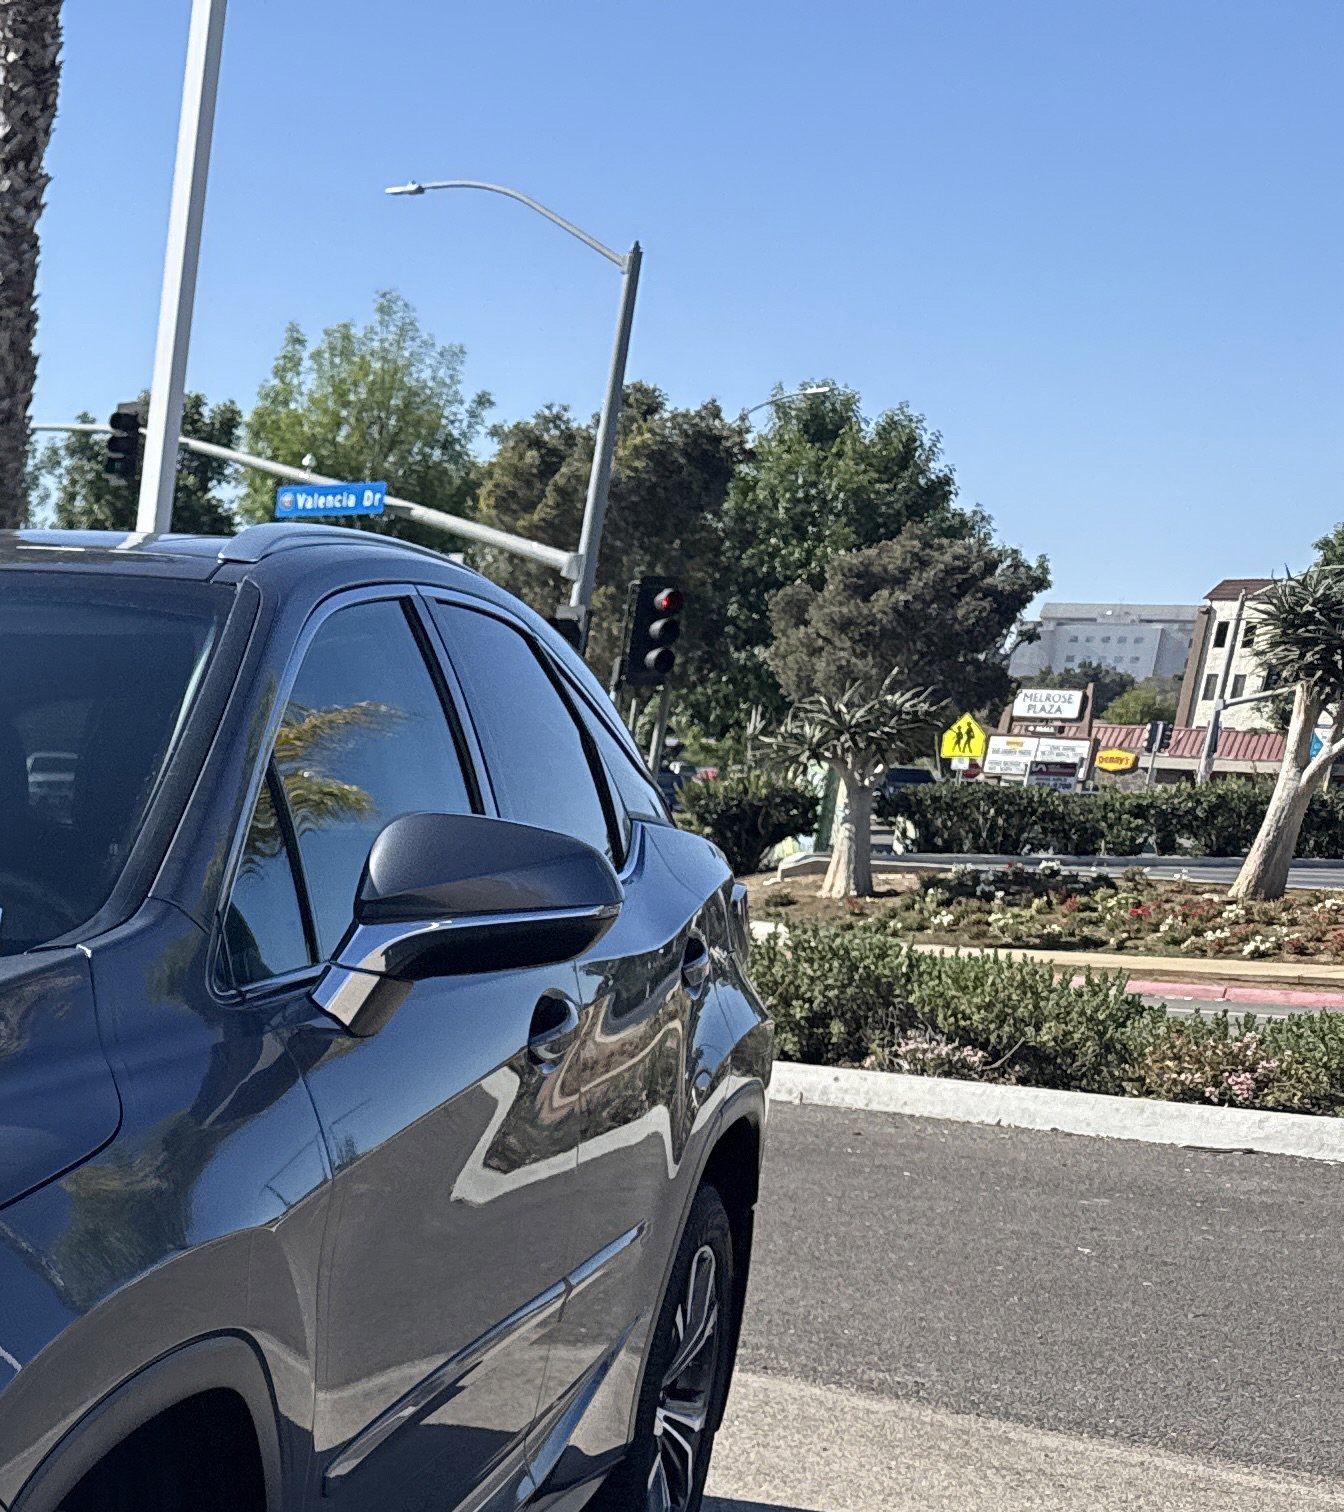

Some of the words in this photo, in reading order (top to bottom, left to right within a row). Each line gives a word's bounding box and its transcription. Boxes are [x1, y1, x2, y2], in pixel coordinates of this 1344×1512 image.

[296, 492, 356, 510] Valencia
[363, 489, 381, 507] Dr
[1023, 692, 1074, 705] MELROSE
[1027, 704, 1063, 715] PLAZA
